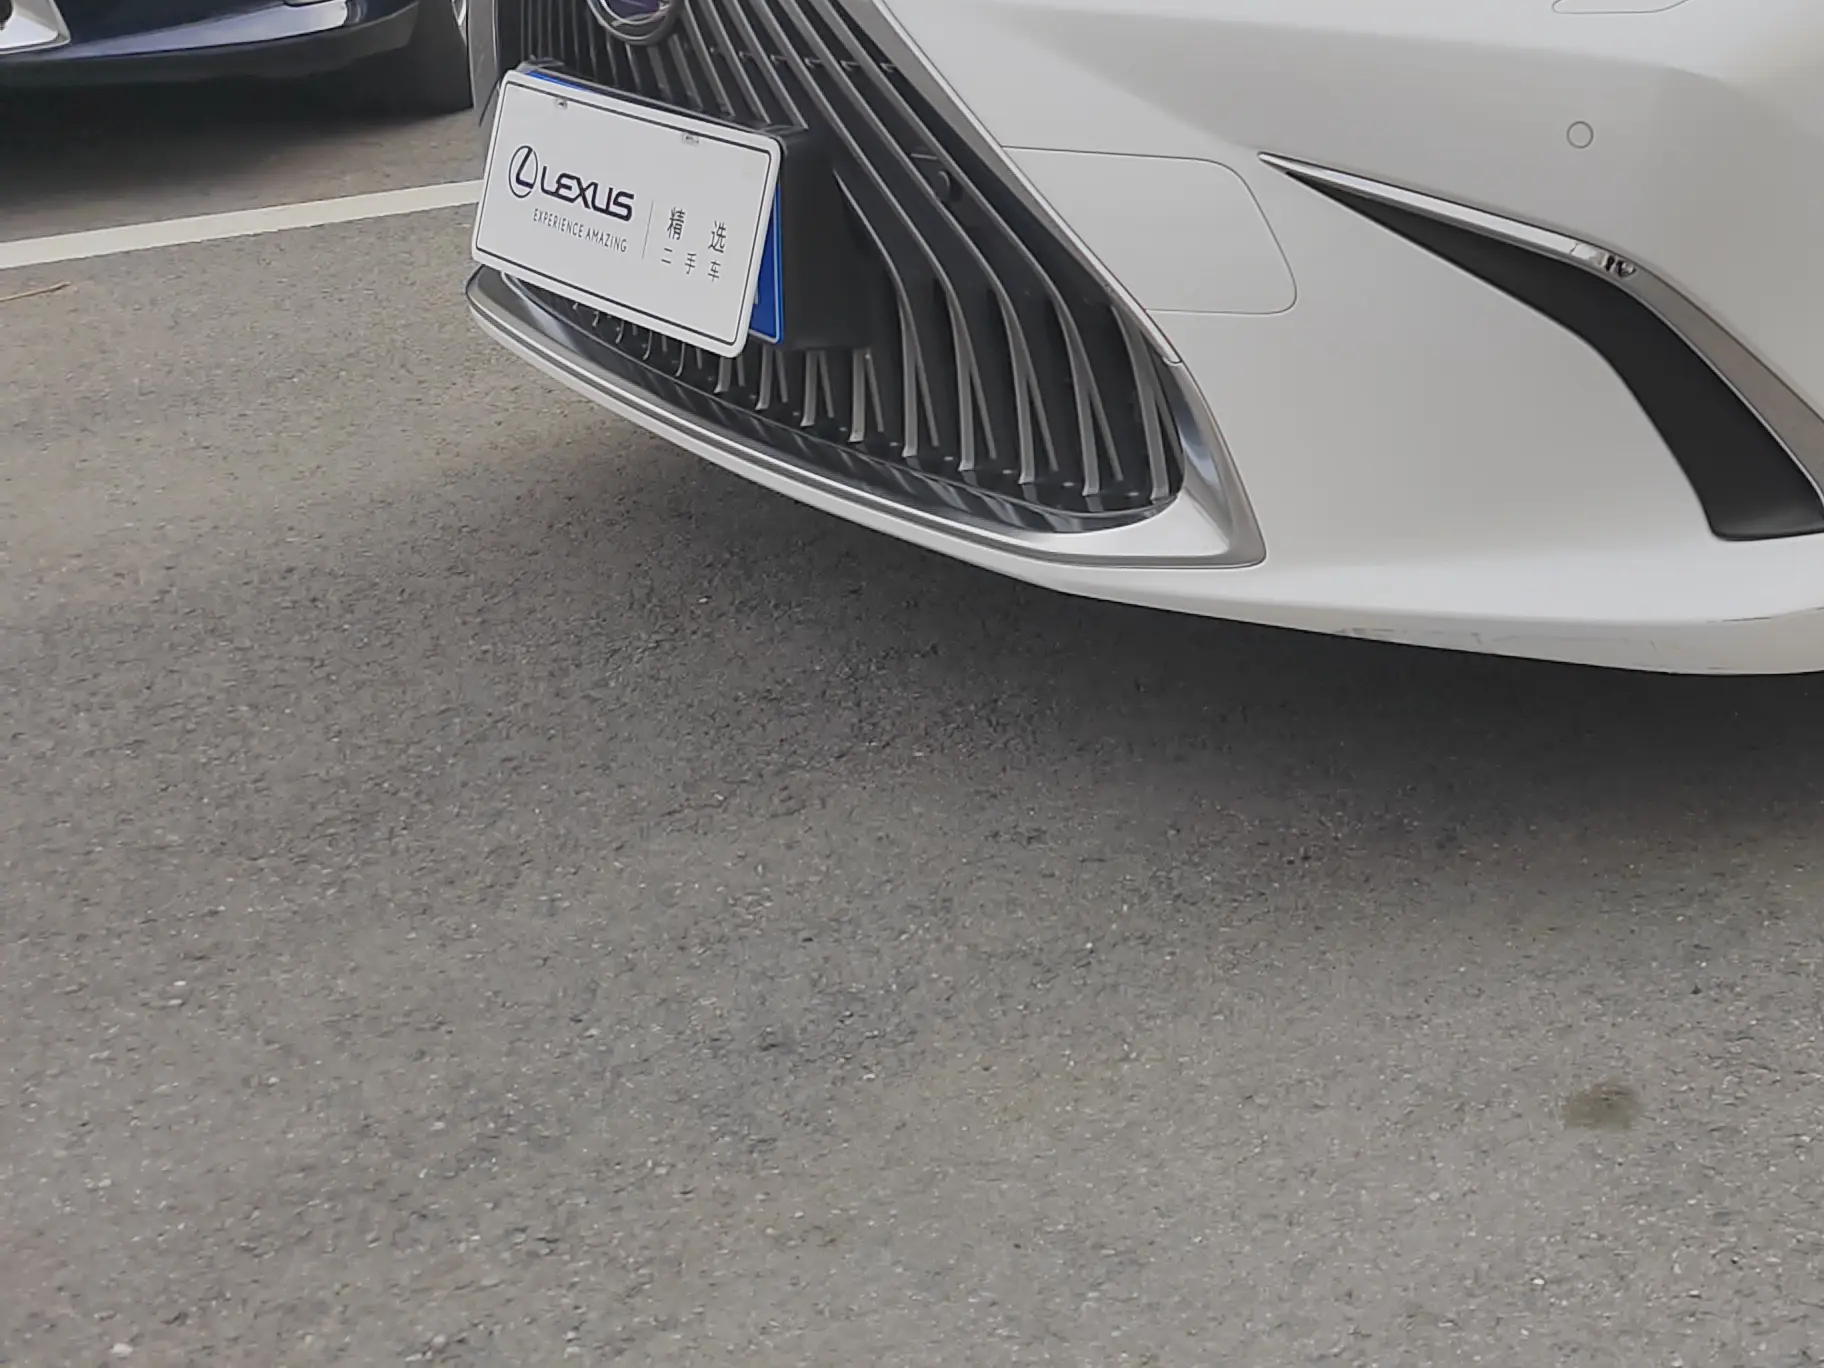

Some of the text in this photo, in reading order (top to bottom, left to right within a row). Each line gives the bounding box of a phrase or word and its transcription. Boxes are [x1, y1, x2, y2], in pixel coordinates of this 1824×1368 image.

[540, 166, 635, 222] LEXUS
[533, 208, 628, 253] EXPERIENCE AMAZING
[667, 206, 727, 254] 精选
[661, 246, 722, 282] 二手车
